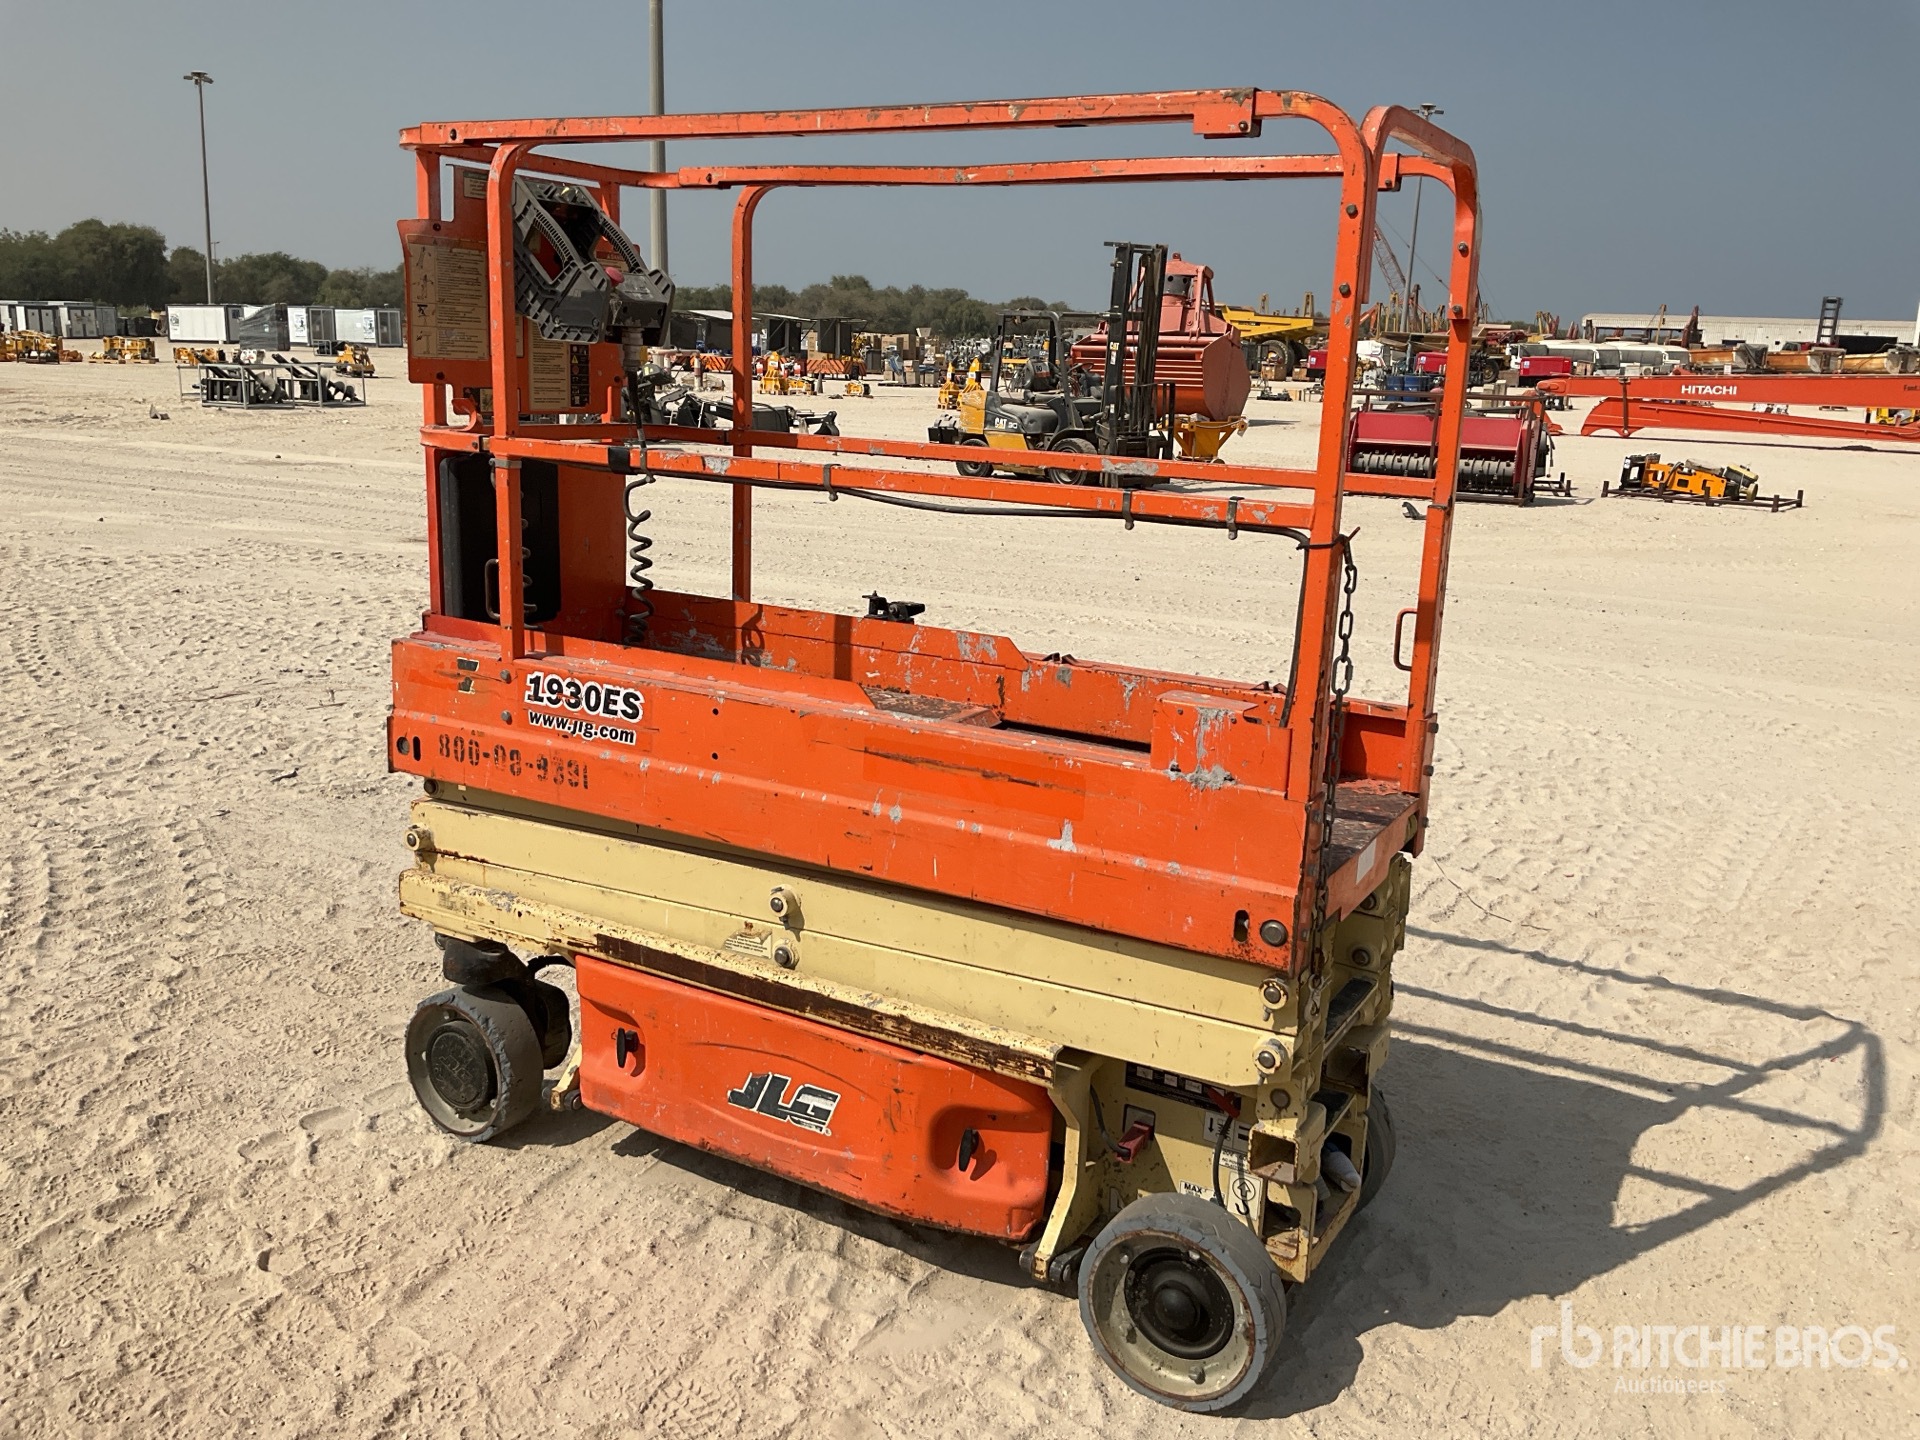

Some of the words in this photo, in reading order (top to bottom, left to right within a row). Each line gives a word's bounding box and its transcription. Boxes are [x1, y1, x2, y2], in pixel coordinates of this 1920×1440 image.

[1680, 384, 1738, 395] HITACHI
[994, 417, 1008, 430] CAT
[525, 672, 643, 721] 1930ES
[528, 710, 636, 744] www.jlg.com
[727, 1071, 841, 1135] JLG
